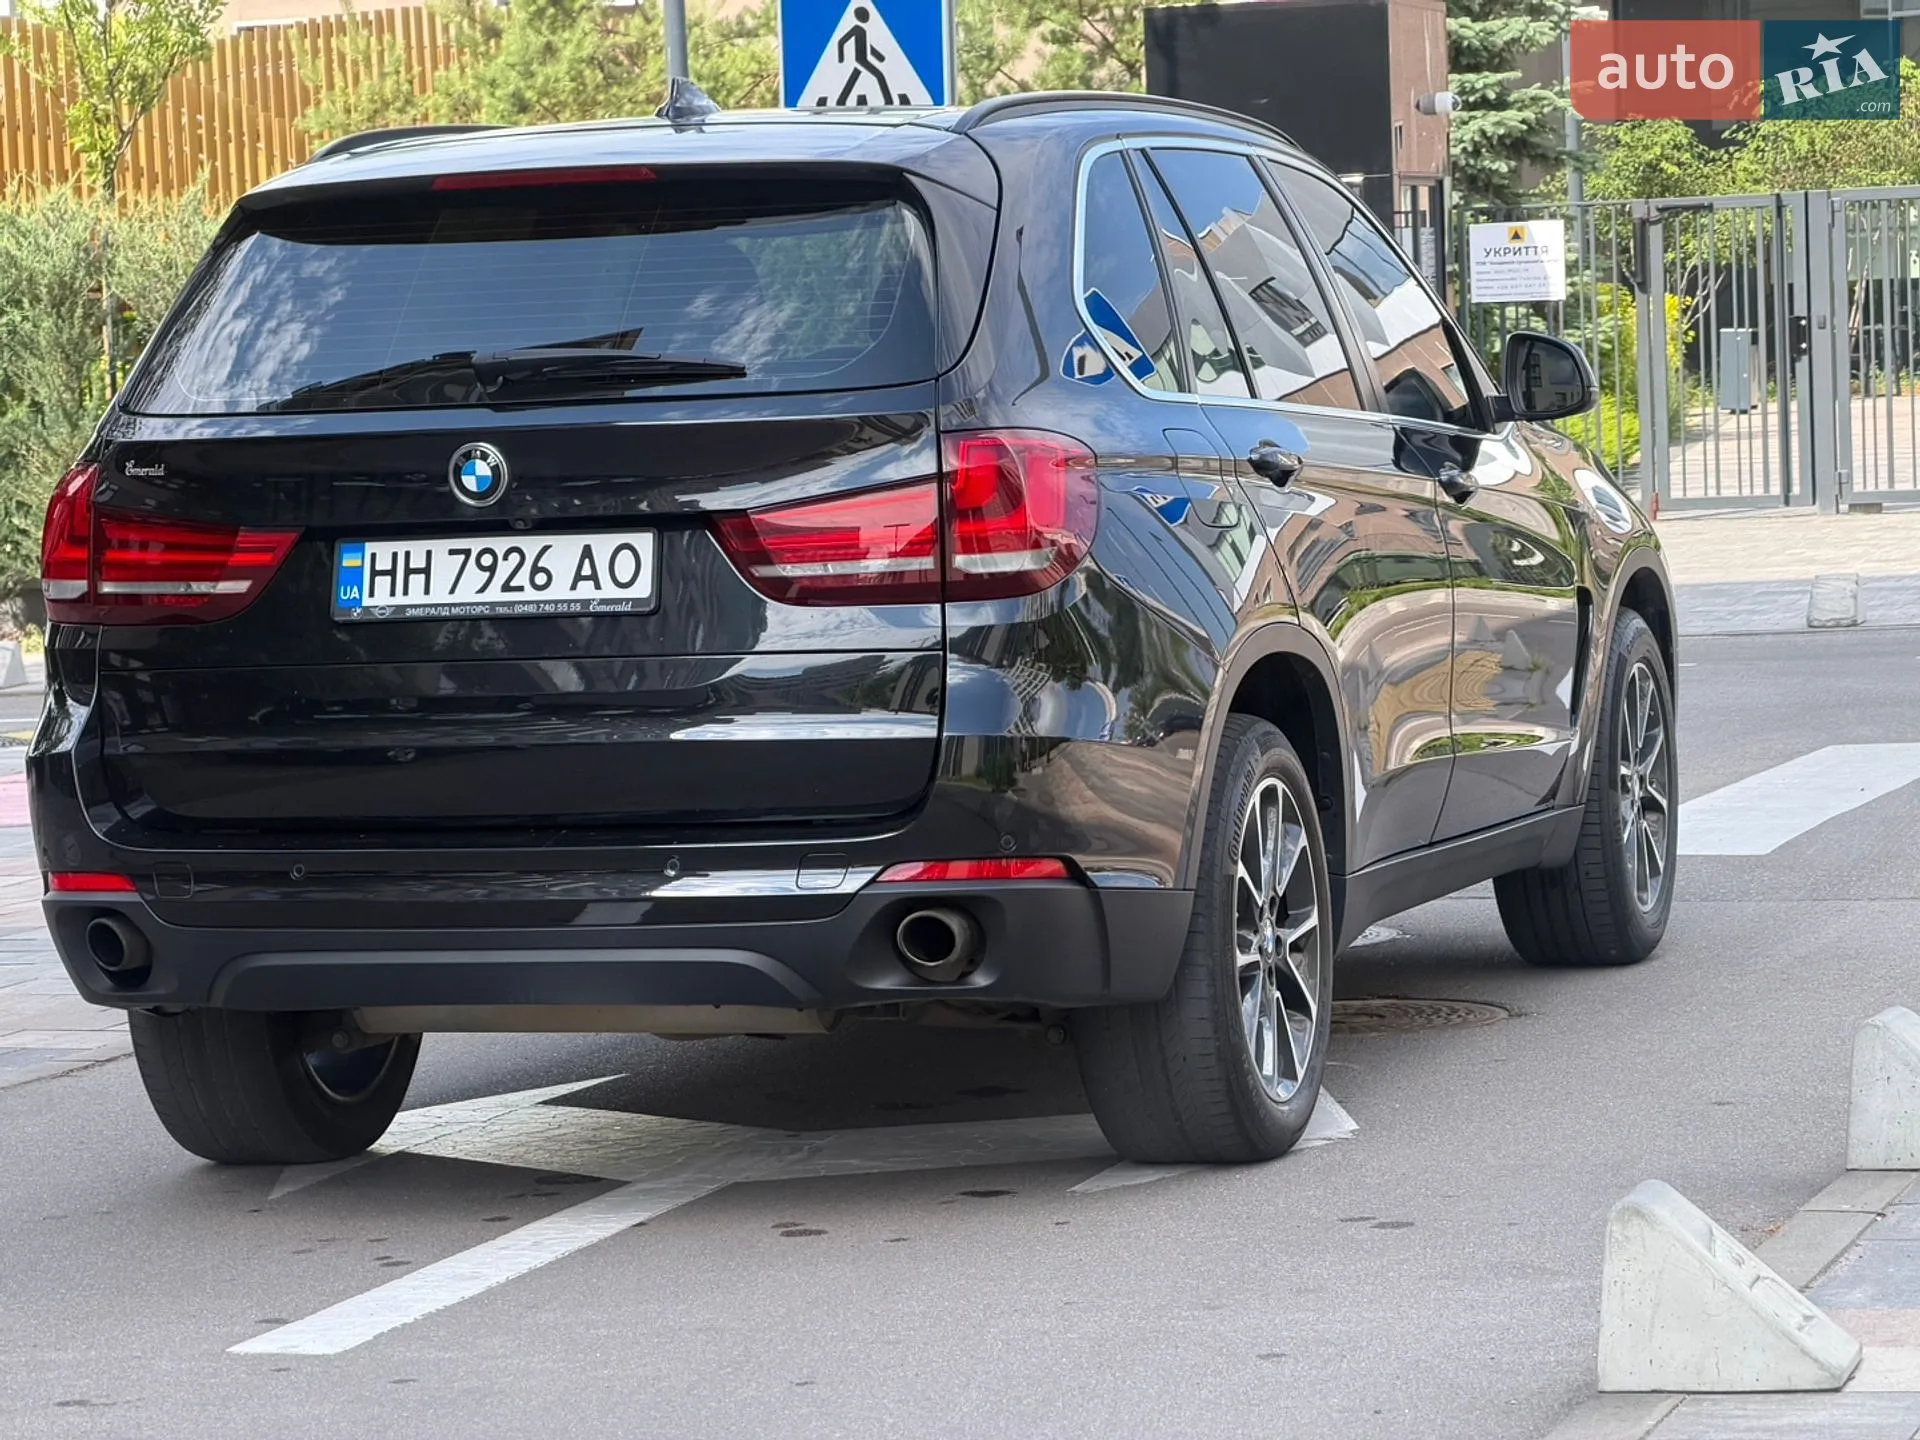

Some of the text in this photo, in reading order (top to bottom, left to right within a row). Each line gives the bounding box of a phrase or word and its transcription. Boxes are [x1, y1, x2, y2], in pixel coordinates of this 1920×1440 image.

[1483, 245, 1549, 258] УКРИТТЯ
[455, 449, 498, 467] BMW
[125, 460, 165, 476] Emerald
[367, 542, 642, 598] HH 7926 AO
[340, 586, 360, 600] UA
[404, 606, 451, 617] ЭМЕРАЛД
[451, 605, 490, 616] МОТОРС
[539, 603, 556, 613] 740
[557, 603, 569, 612] 55
[569, 602, 582, 612] 55
[589, 599, 633, 612] Emerald
